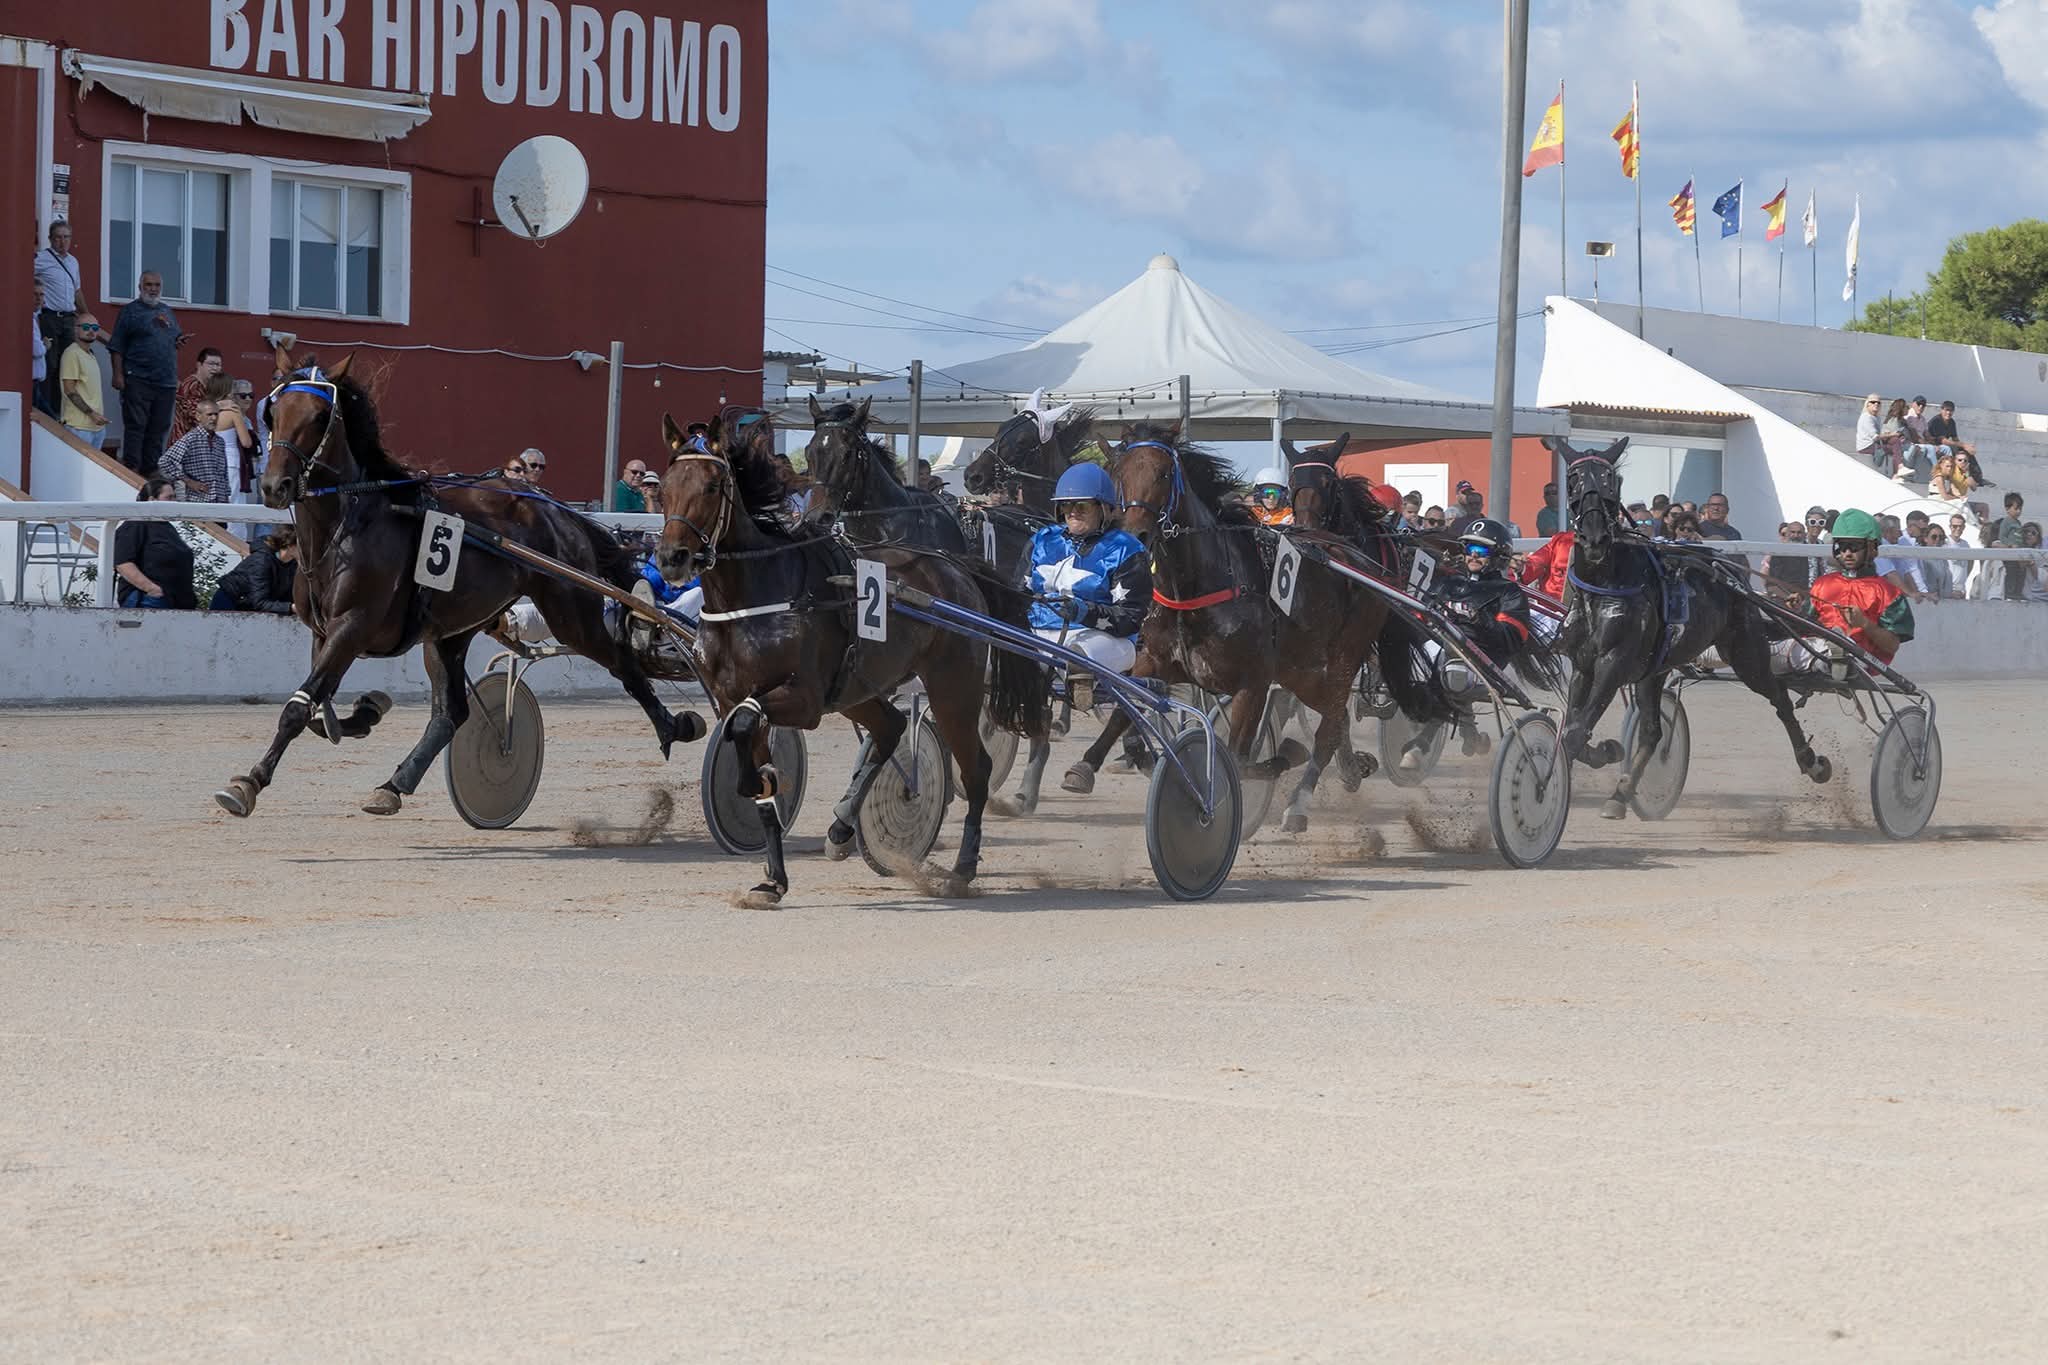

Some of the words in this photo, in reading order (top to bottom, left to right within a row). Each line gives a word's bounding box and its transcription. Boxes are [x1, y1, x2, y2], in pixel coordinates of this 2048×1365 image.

[210, 0, 346, 83] BAR
[371, 0, 742, 133] HIPODROMO
[426, 525, 453, 576] 5
[1278, 552, 1293, 600] 6
[864, 576, 881, 628] 2
[1415, 561, 1430, 599] 7
